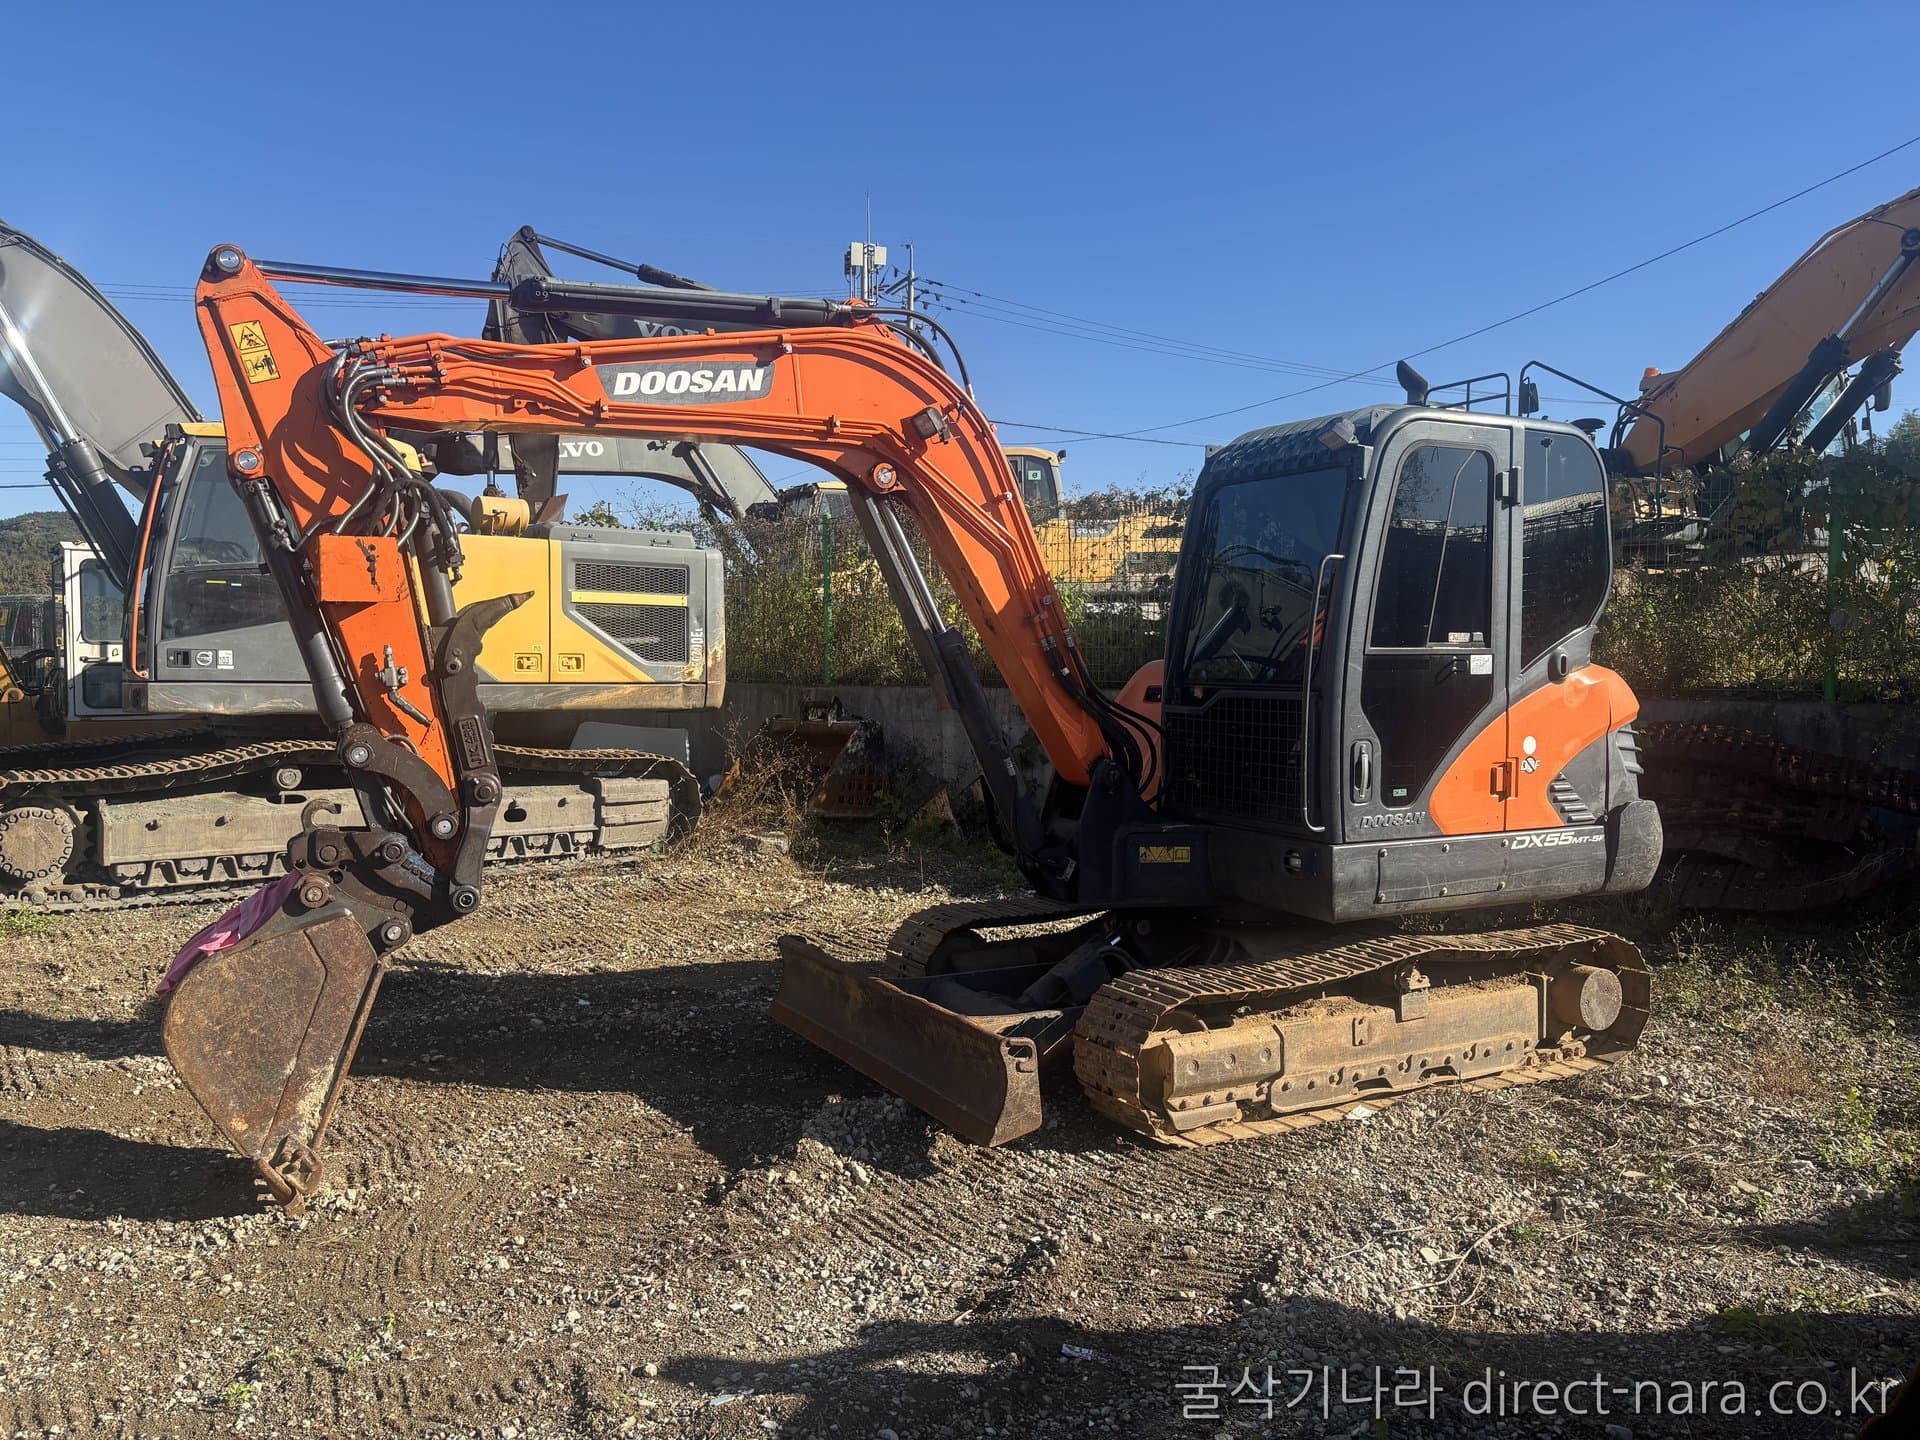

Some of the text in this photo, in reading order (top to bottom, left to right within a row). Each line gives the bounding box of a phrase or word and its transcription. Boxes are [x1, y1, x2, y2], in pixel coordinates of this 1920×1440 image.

[634, 319, 699, 337] VO
[613, 368, 764, 395] DOOSAN
[1360, 811, 1426, 829] DOOSAN
